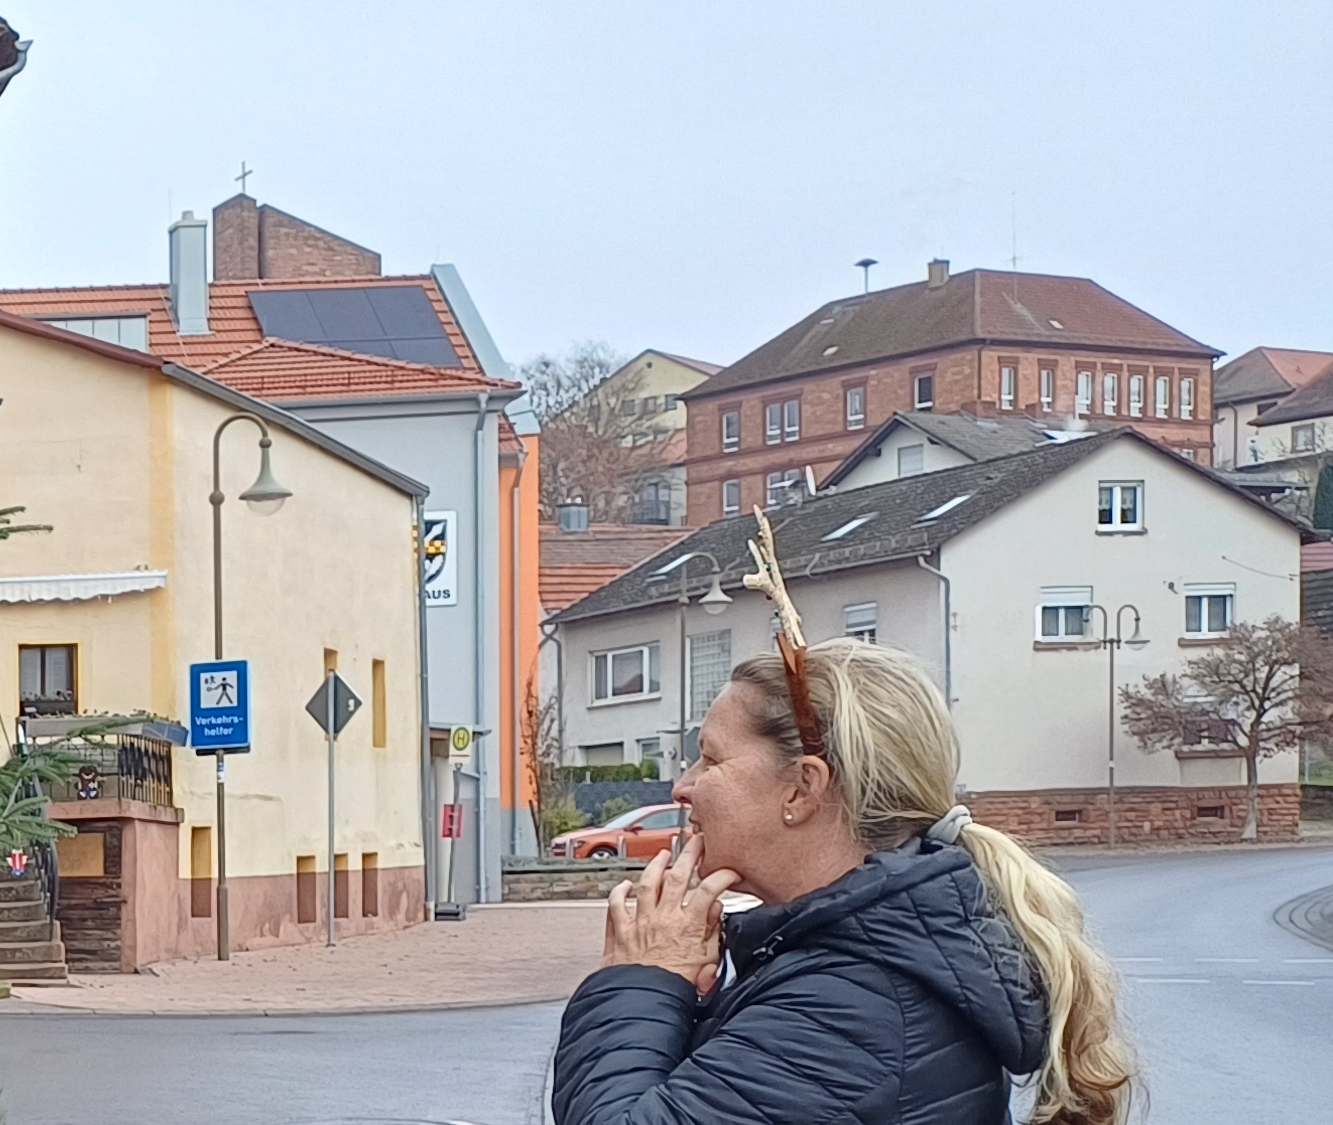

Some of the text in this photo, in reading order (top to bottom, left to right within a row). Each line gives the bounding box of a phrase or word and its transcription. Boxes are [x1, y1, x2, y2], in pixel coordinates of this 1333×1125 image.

[424, 589, 450, 599] AUS
[195, 714, 243, 725] Verkehrs-
[204, 726, 234, 736] helfer
